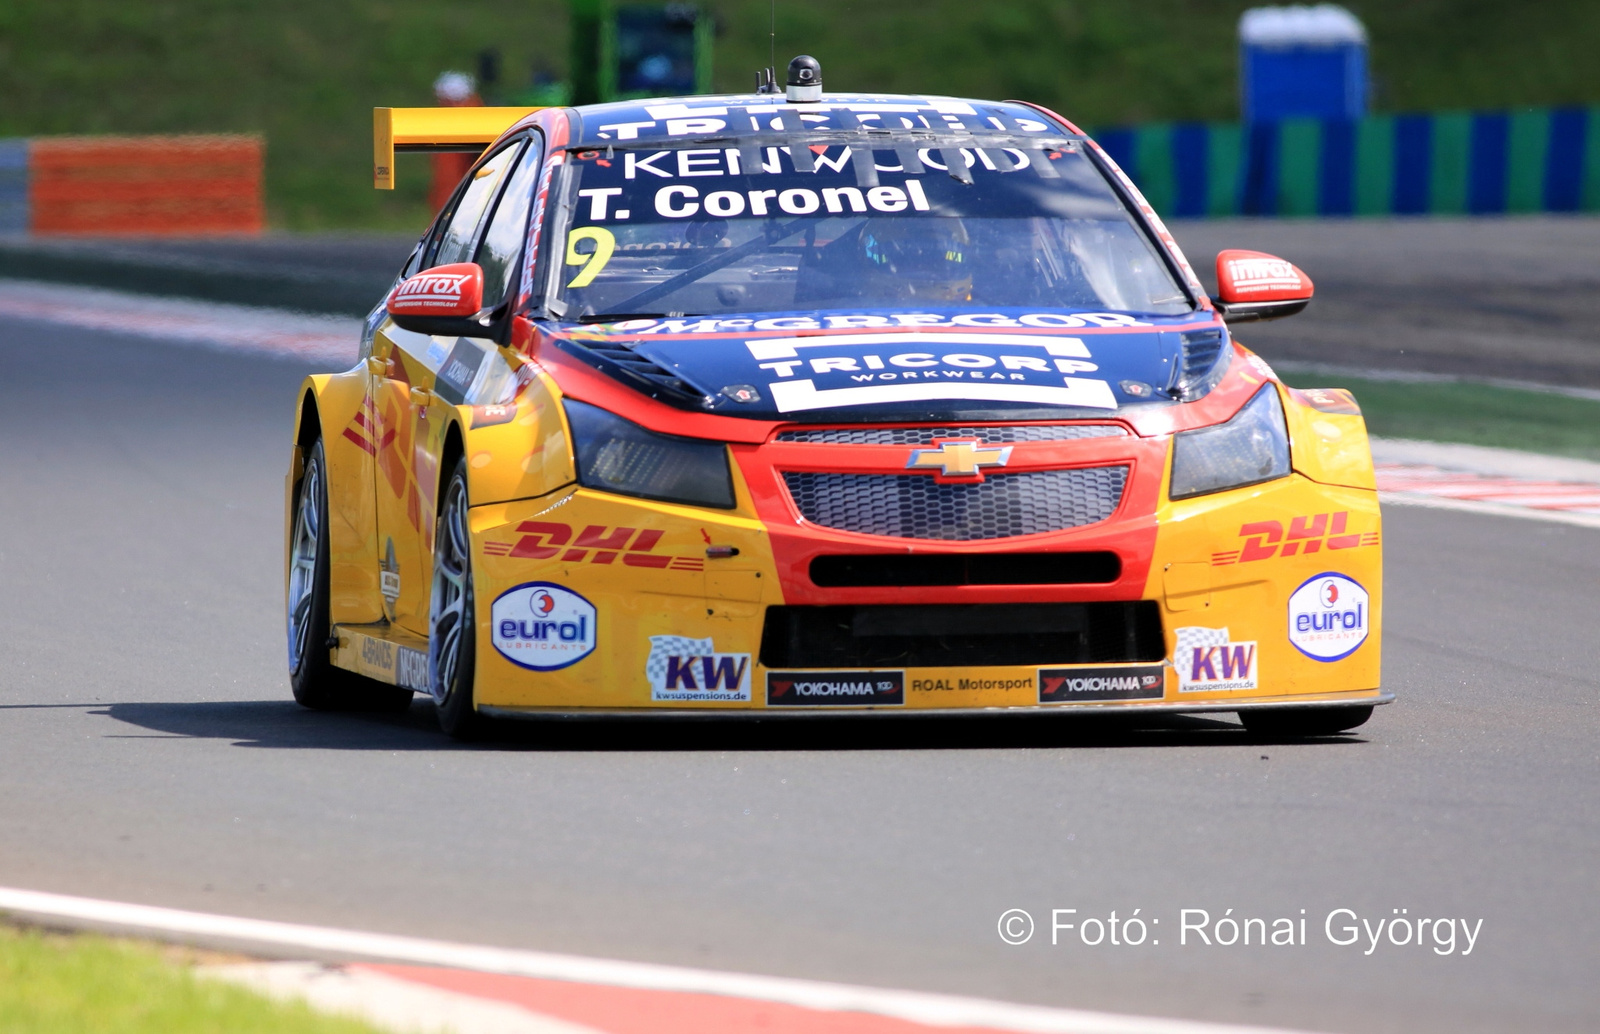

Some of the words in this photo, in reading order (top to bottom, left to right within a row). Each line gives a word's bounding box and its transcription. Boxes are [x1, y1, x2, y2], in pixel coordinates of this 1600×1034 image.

[578, 187, 631, 221] T.
[653, 179, 931, 218] Coronel
[565, 226, 616, 288] 9
[758, 352, 1099, 378] TRICORP
[850, 370, 1026, 383] WORKWEAR
[508, 520, 673, 569] DHL
[1238, 511, 1361, 564] DHL
[499, 614, 588, 643] eurol
[1296, 602, 1364, 633] eurol
[498, 641, 588, 652] LUBRICANTS
[1294, 631, 1364, 643] LUBRICANTS
[664, 655, 749, 691] KW
[1190, 644, 1255, 683] KW
[655, 690, 748, 702] kwsuspensions.de
[793, 682, 875, 696] YOKOHAMA
[911, 679, 954, 692] ROAL
[958, 677, 1033, 692] Motorsport
[1065, 676, 1141, 692] YOKOHAMA
[1182, 680, 1255, 692] kwsuspensions.de
